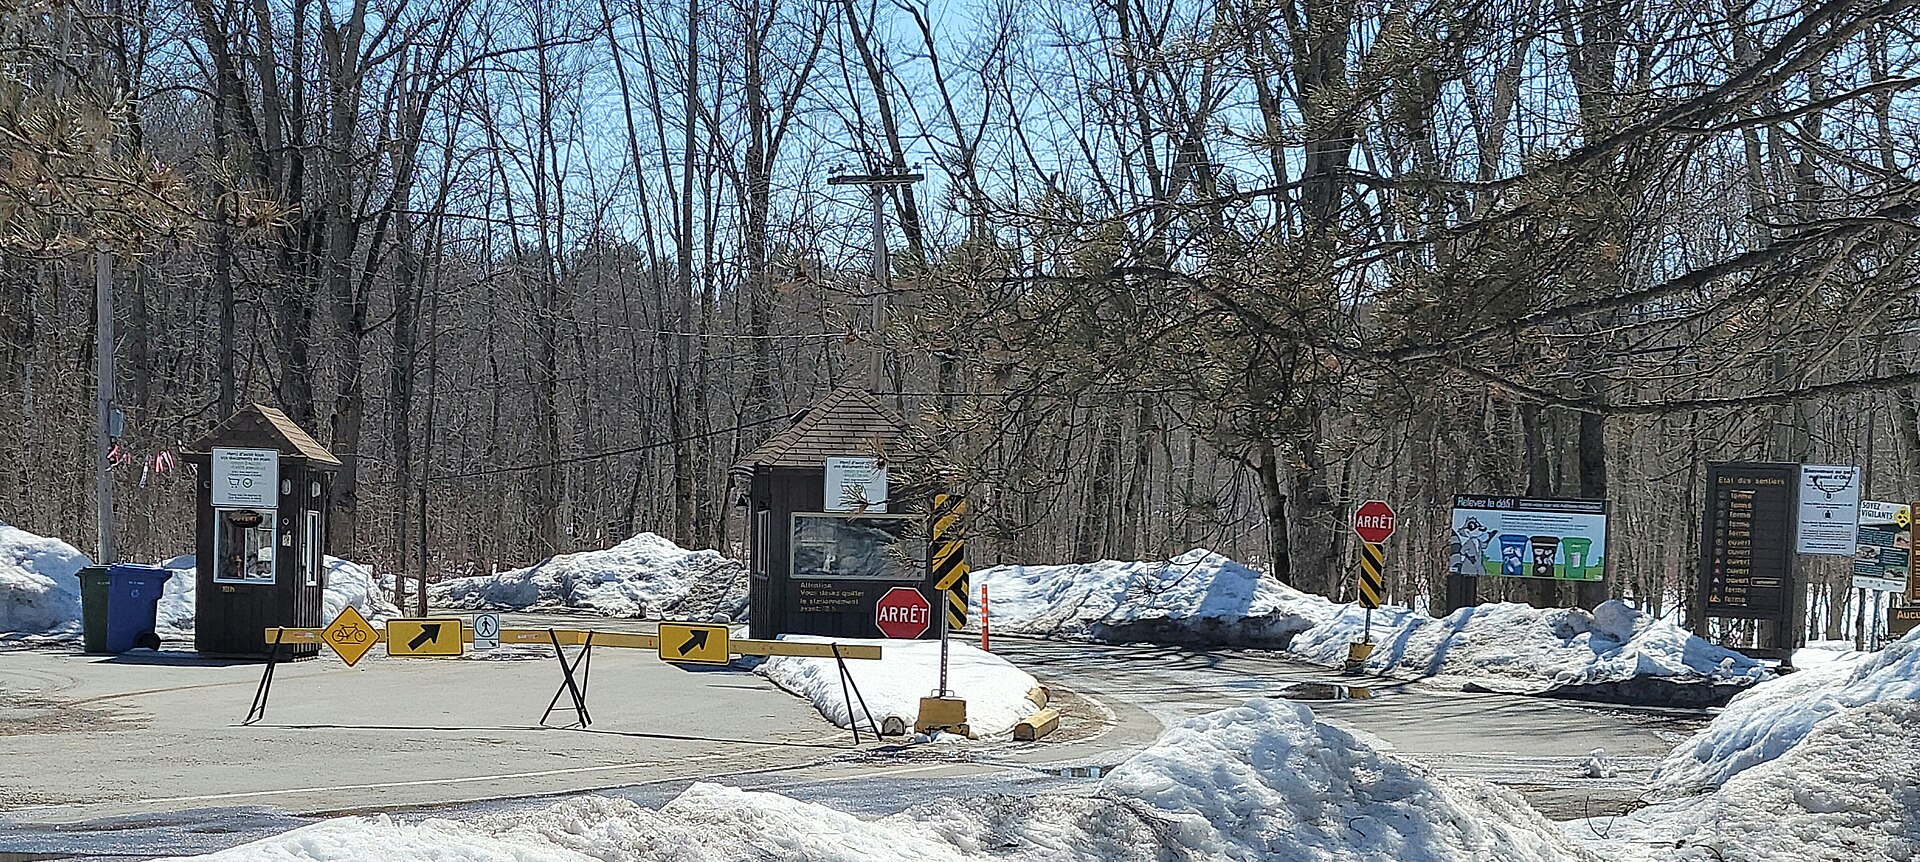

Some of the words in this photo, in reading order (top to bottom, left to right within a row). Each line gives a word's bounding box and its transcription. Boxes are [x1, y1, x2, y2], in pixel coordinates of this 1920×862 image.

[1457, 496, 1486, 508] Relevez
[1487, 498, 1495, 508] la
[1861, 501, 1882, 511] SOYEZ
[1861, 509, 1893, 520] VIGILANTS
[1356, 514, 1393, 530] ARRÊT
[879, 605, 928, 624] ARRÊT
